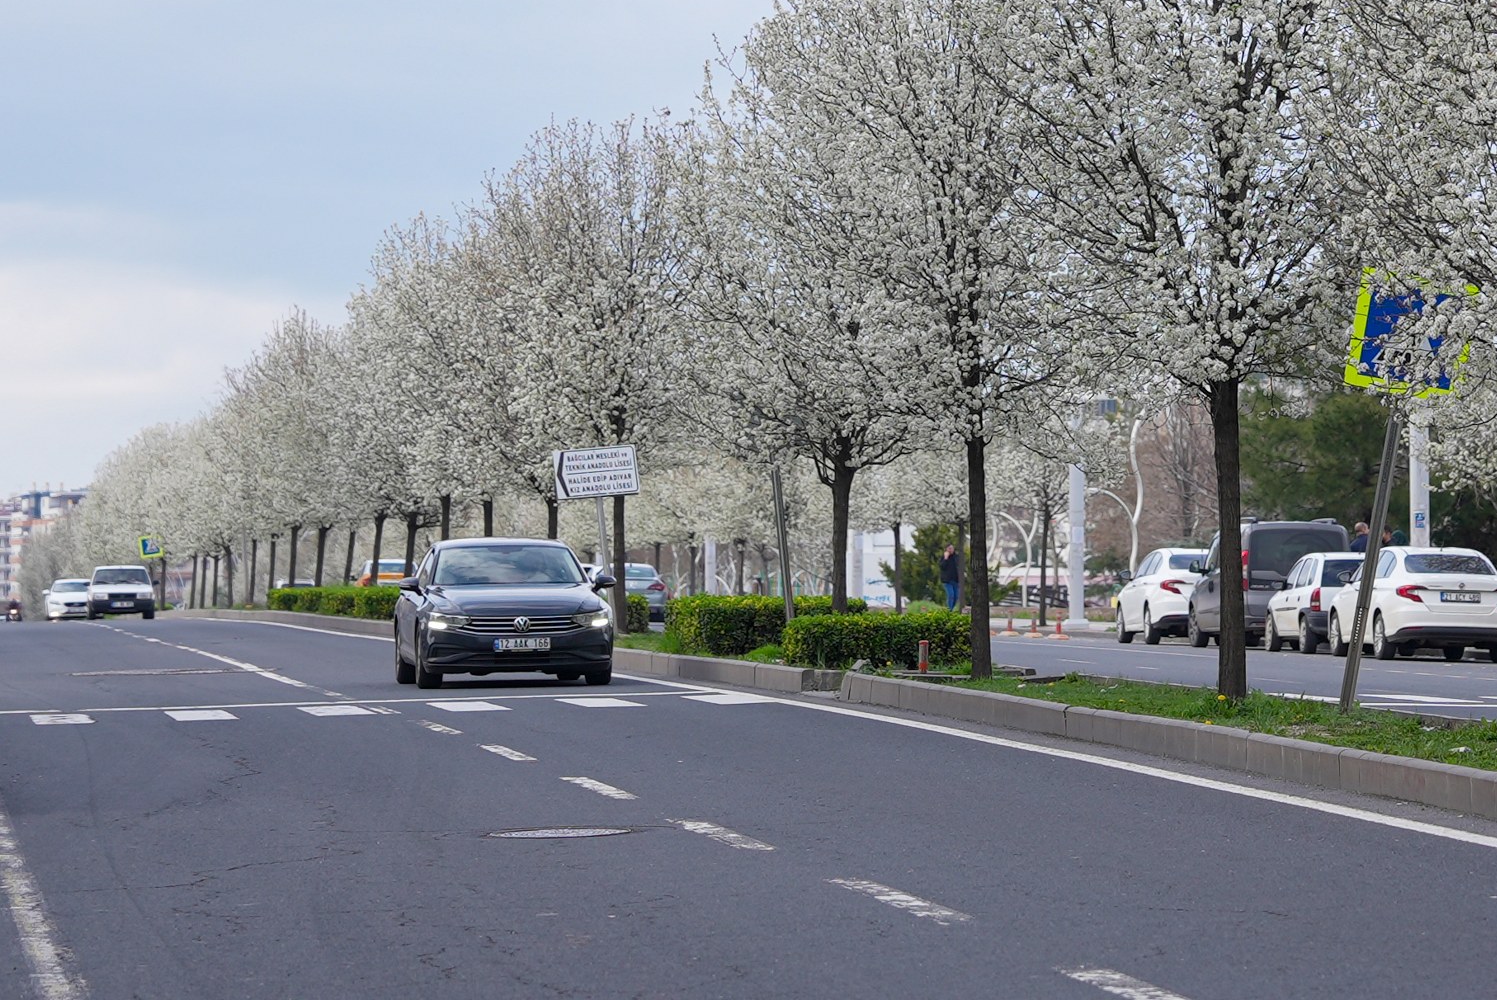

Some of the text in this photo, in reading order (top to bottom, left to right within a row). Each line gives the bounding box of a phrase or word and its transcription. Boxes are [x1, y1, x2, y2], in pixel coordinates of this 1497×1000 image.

[596, 450, 619, 459] MESLEKİ
[565, 458, 632, 471] TEKNİK ANADOLU LİSESİ
[568, 473, 632, 484] HALİDE EDİP ADIVAR
[582, 483, 611, 492] ANADOLU
[613, 481, 633, 489] LİSESİ
[501, 639, 549, 648] 12 AAK 166
